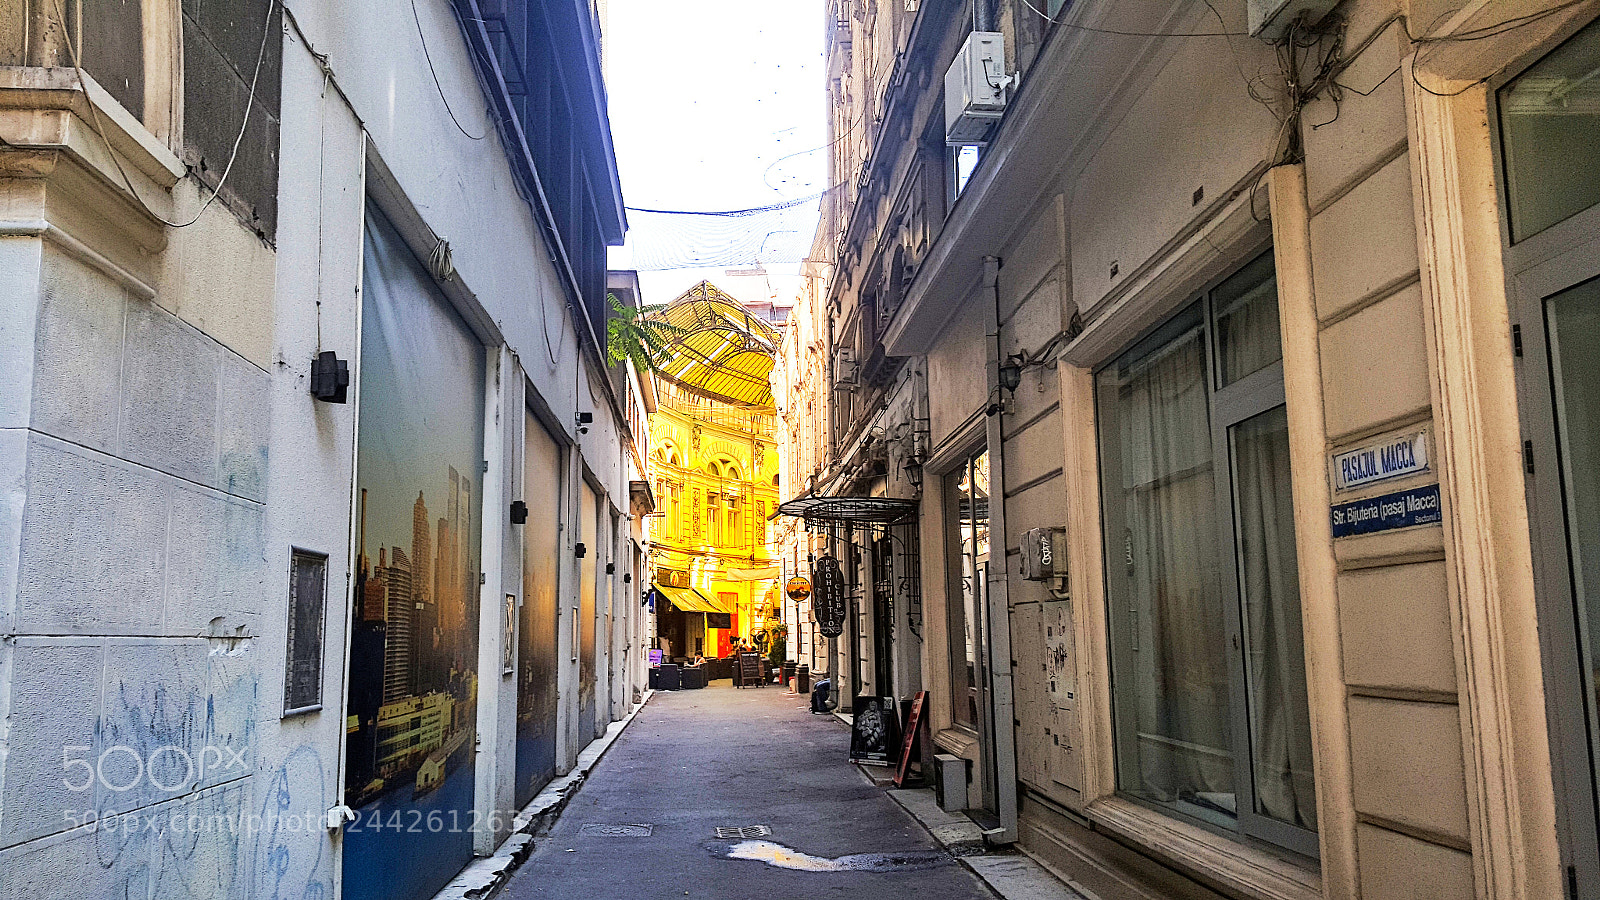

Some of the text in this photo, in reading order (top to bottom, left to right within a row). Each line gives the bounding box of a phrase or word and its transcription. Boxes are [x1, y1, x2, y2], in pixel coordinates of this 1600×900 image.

[1341, 439, 1416, 483] PASAJUL MACCA
[1333, 509, 1346, 525] Str.
[1379, 500, 1406, 521] (pasaj
[1406, 489, 1440, 512] Macca)
[825, 559, 836, 634] PROHIBITION
[834, 583, 842, 609] CLUB
